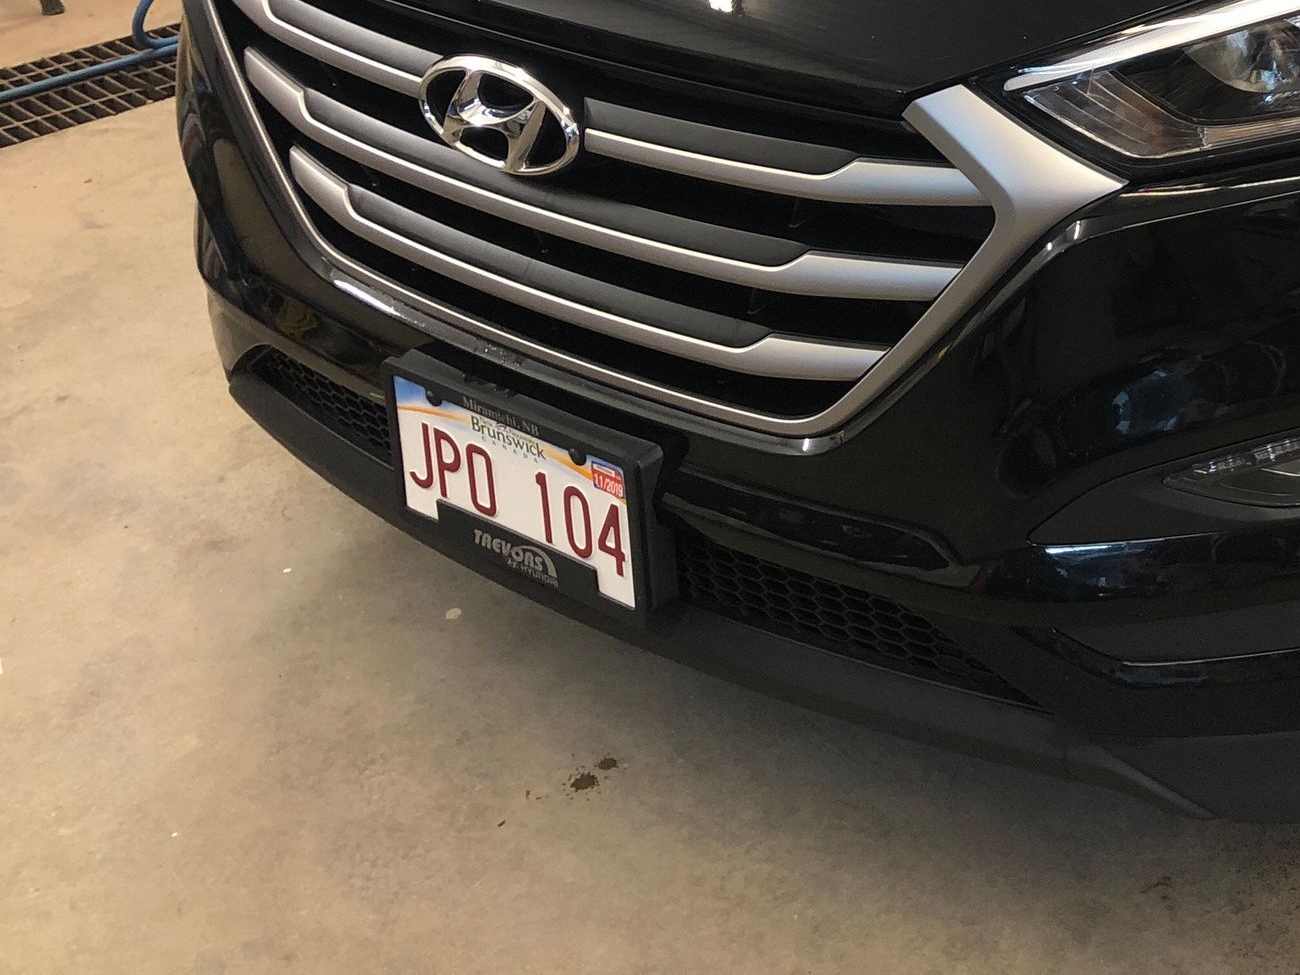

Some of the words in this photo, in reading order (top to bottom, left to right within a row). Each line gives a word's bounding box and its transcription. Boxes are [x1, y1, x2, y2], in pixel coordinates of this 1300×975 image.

[470, 414, 547, 461] Brunswick
[521, 418, 540, 436] NB
[481, 435, 538, 464] CANADA
[594, 472, 624, 497] 11/2019
[409, 421, 497, 518] JPO
[535, 470, 627, 578] 104
